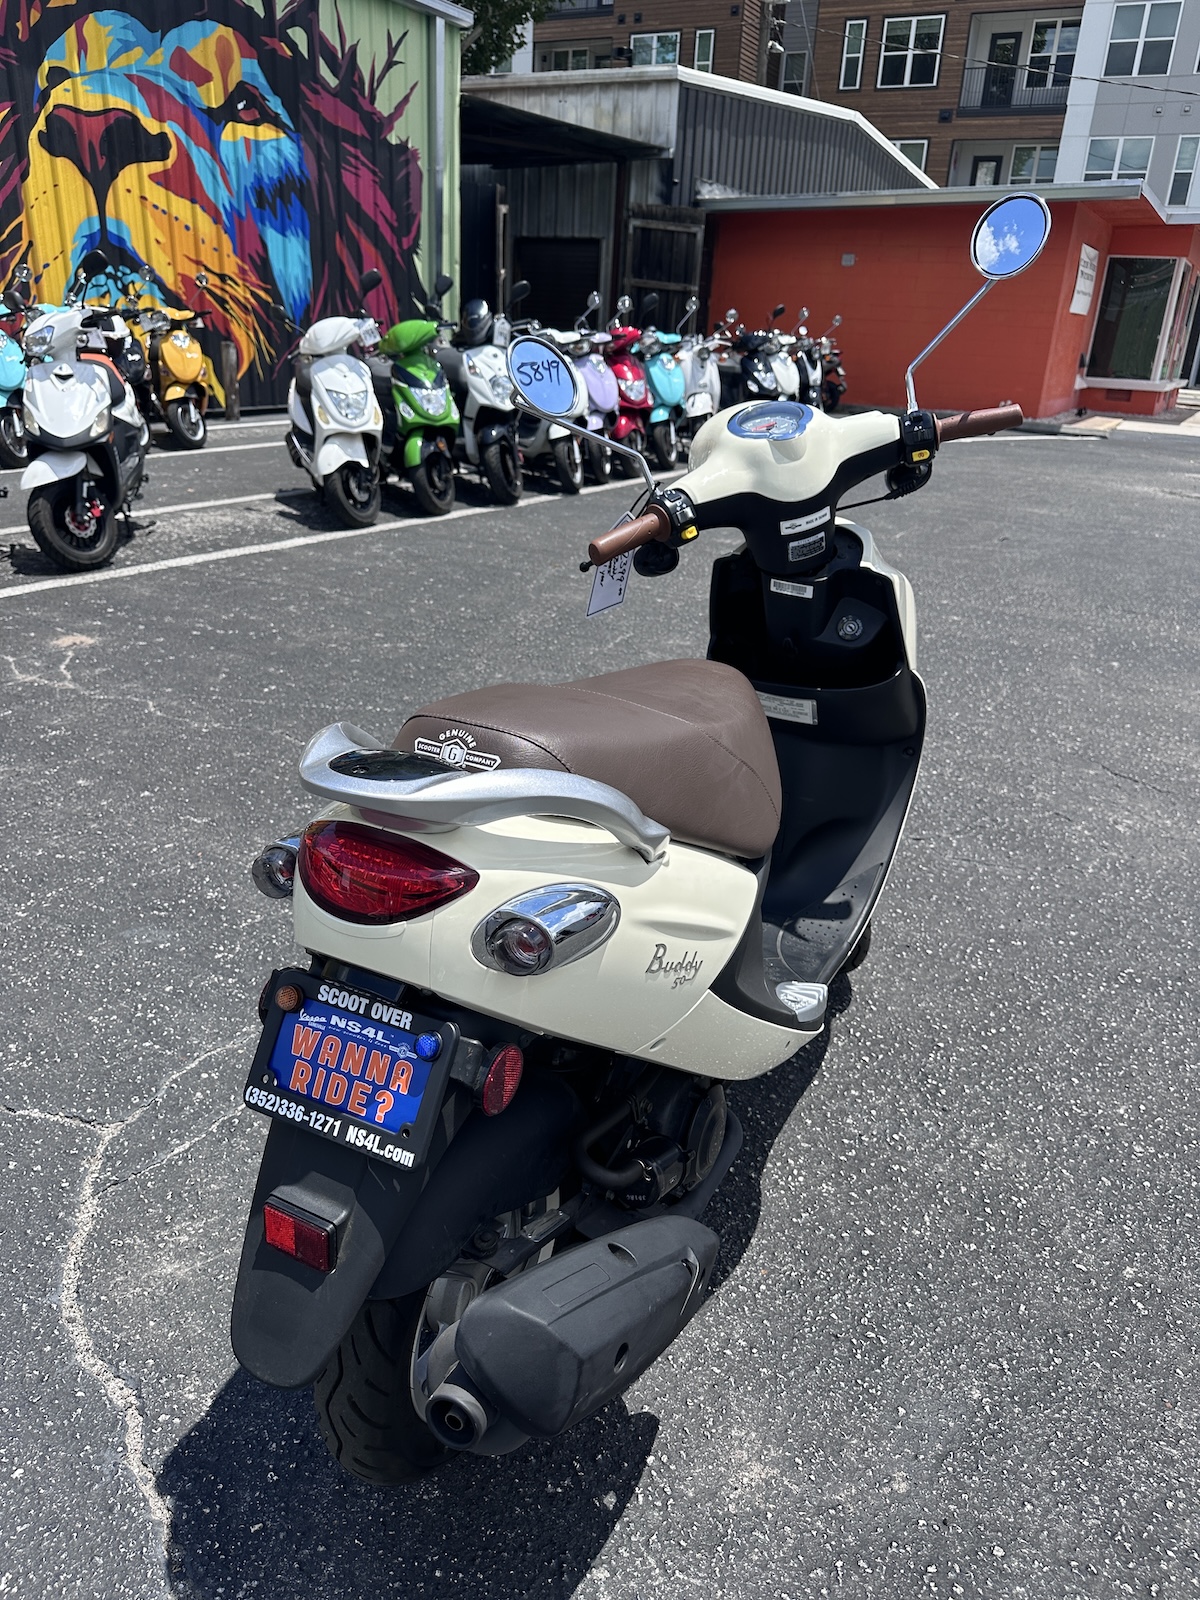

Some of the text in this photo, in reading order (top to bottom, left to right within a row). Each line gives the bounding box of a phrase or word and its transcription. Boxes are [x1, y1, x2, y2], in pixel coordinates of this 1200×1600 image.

[517, 359, 560, 386] 5849
[418, 743, 440, 754] SCOOTER
[466, 754, 495, 766] COMPANY
[439, 729, 476, 749] GENUINE
[645, 943, 703, 980] Buddy
[671, 975, 686, 989] 50
[299, 1007, 391, 1044] Vespa NS4L
[317, 984, 413, 1031] SCOOT OVER
[291, 1023, 414, 1095] WANNA
[289, 1060, 395, 1124] RIDE?
[245, 1085, 416, 1169] (352)336-1271 NS4L.com
